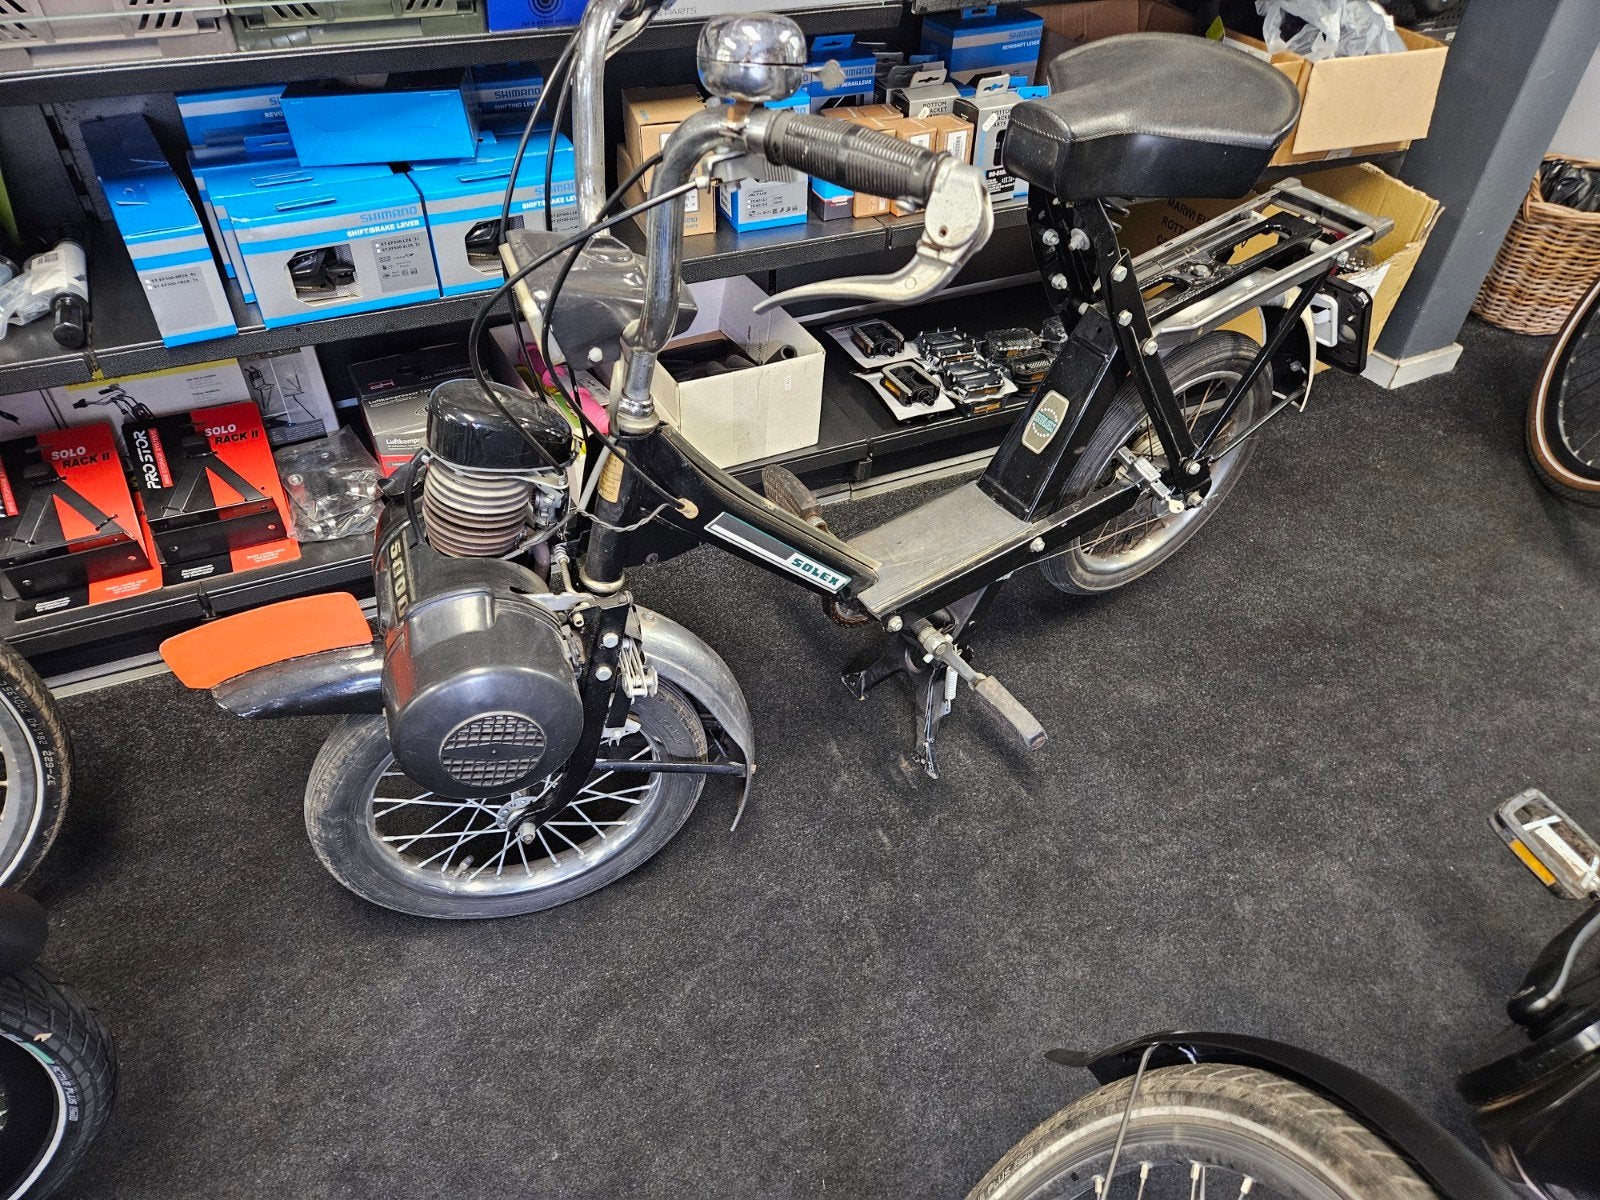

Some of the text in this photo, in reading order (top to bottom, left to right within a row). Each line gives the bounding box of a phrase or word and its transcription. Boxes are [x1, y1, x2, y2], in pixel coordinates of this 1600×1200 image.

[1009, 28, 1042, 40] SHIMANO
[844, 67, 873, 76] IMANO
[494, 87, 541, 99] SHIMANO
[360, 206, 418, 223] SHIMANO
[1166, 199, 1195, 219] MARWI
[346, 219, 420, 237] SHIFT/BRAKE LEVER
[204, 423, 237, 437] SOLO
[214, 431, 248, 445] RACK
[251, 429, 259, 438] II
[51, 446, 86, 460] SOLO
[62, 451, 110, 469] RACK II
[791, 557, 840, 586] SOLEX
[42, 750, 57, 786] 37-622
[65, 1087, 78, 1105] PLUS
[987, 1161, 1013, 1196] PLUS
